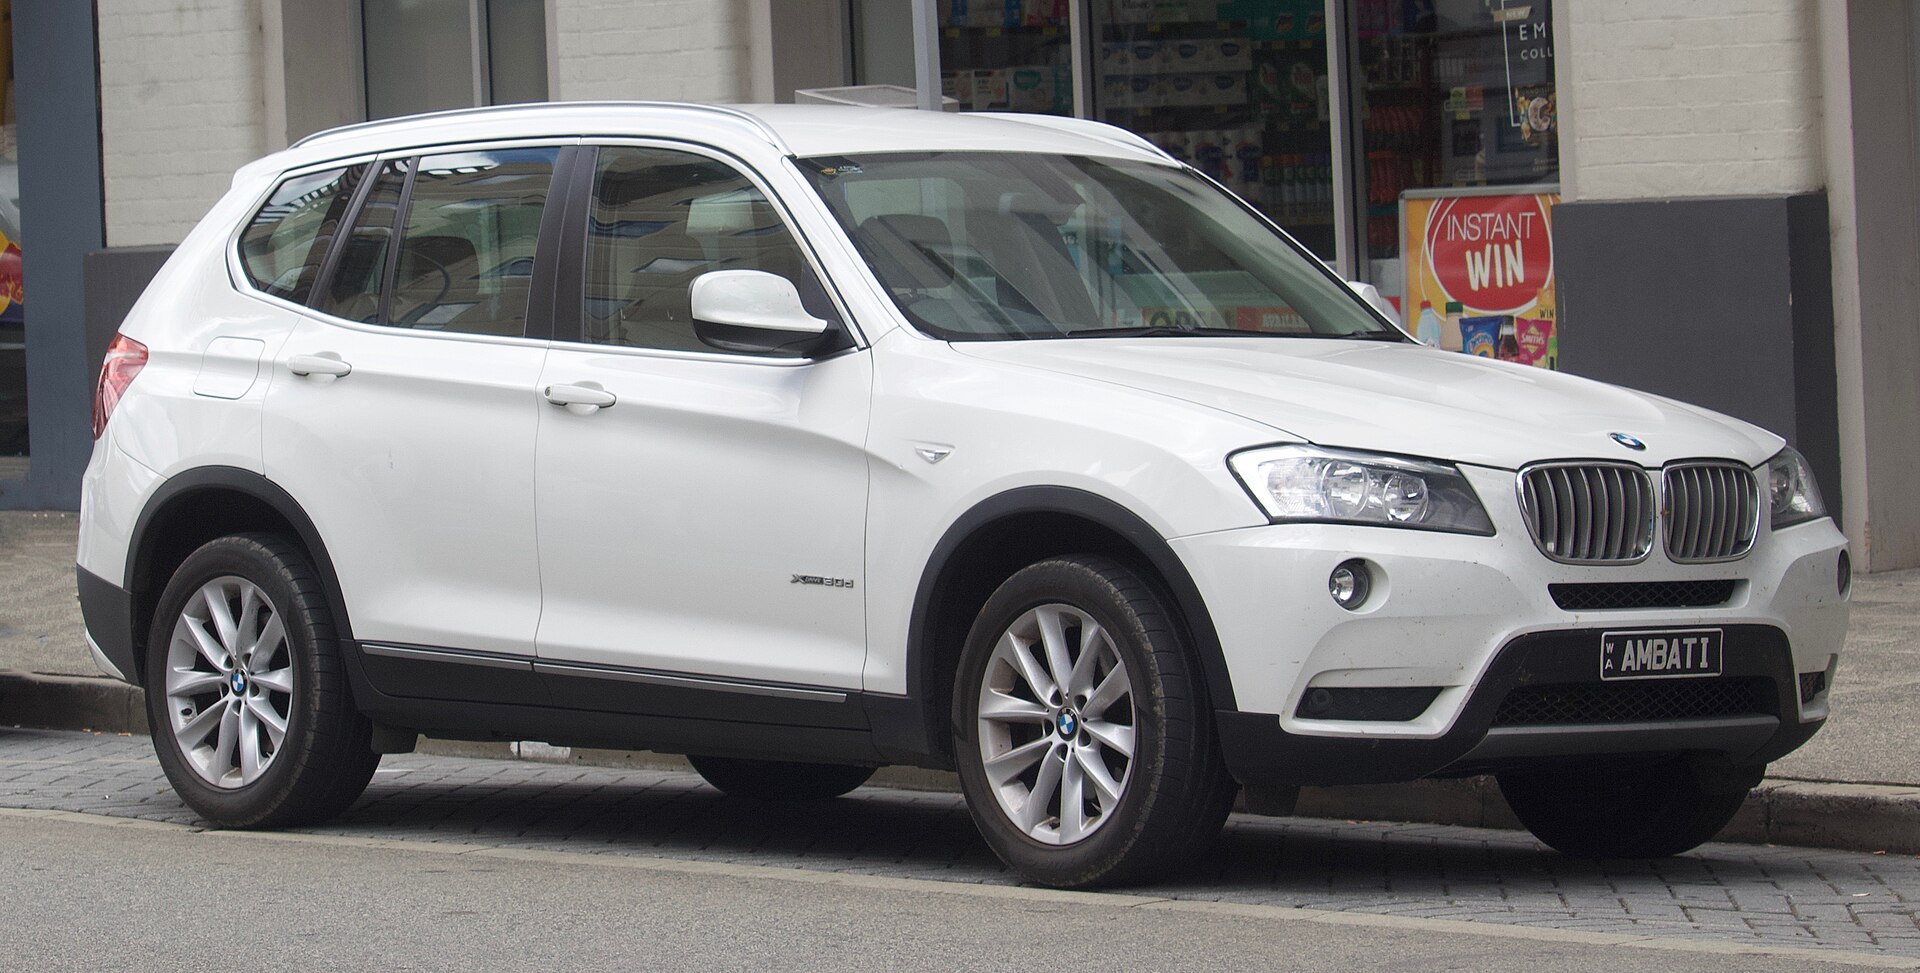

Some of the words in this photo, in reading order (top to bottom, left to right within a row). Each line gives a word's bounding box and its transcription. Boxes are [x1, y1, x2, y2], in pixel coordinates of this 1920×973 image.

[1506, 10, 1525, 18] NEW
[1447, 212, 1536, 241] INSTANT
[1465, 240, 1525, 292] WIN
[1539, 308, 1554, 319] WIN
[1621, 637, 1709, 672] AMBATI
